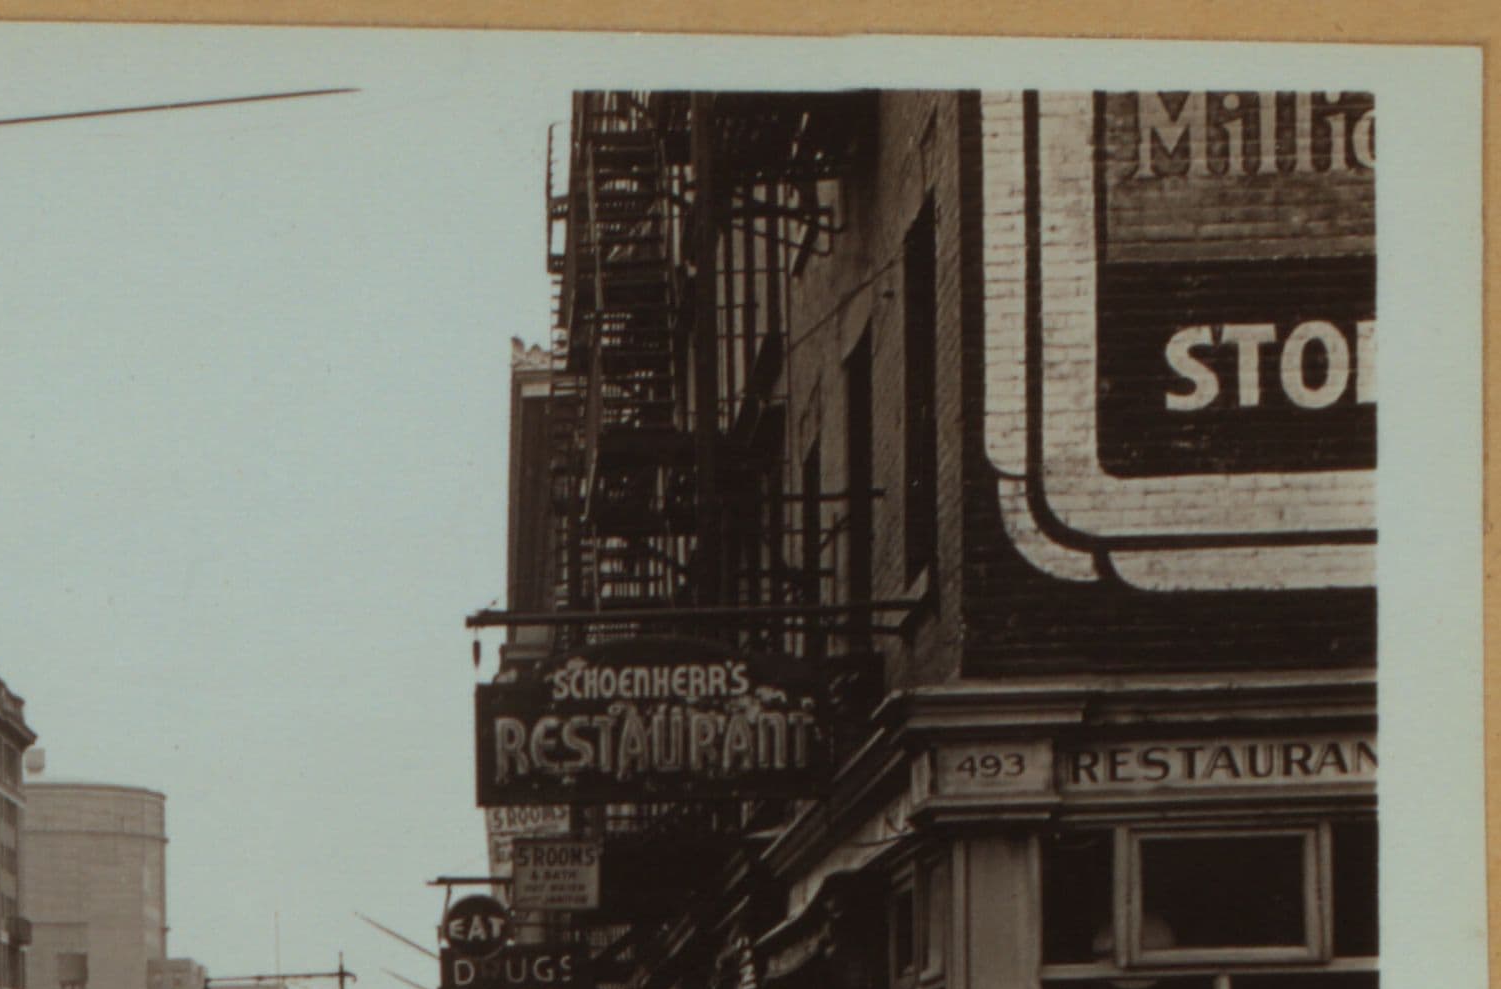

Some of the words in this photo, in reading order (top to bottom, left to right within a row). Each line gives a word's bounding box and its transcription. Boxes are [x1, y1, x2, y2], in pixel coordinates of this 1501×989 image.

[552, 661, 750, 699] SCHOENHERR'S
[494, 703, 815, 775] RESTAURANT
[956, 752, 1027, 780] 493
[1069, 741, 1377, 784] RESTAURAN
[532, 846, 596, 867] ROOMS
[448, 914, 505, 941] EAT
